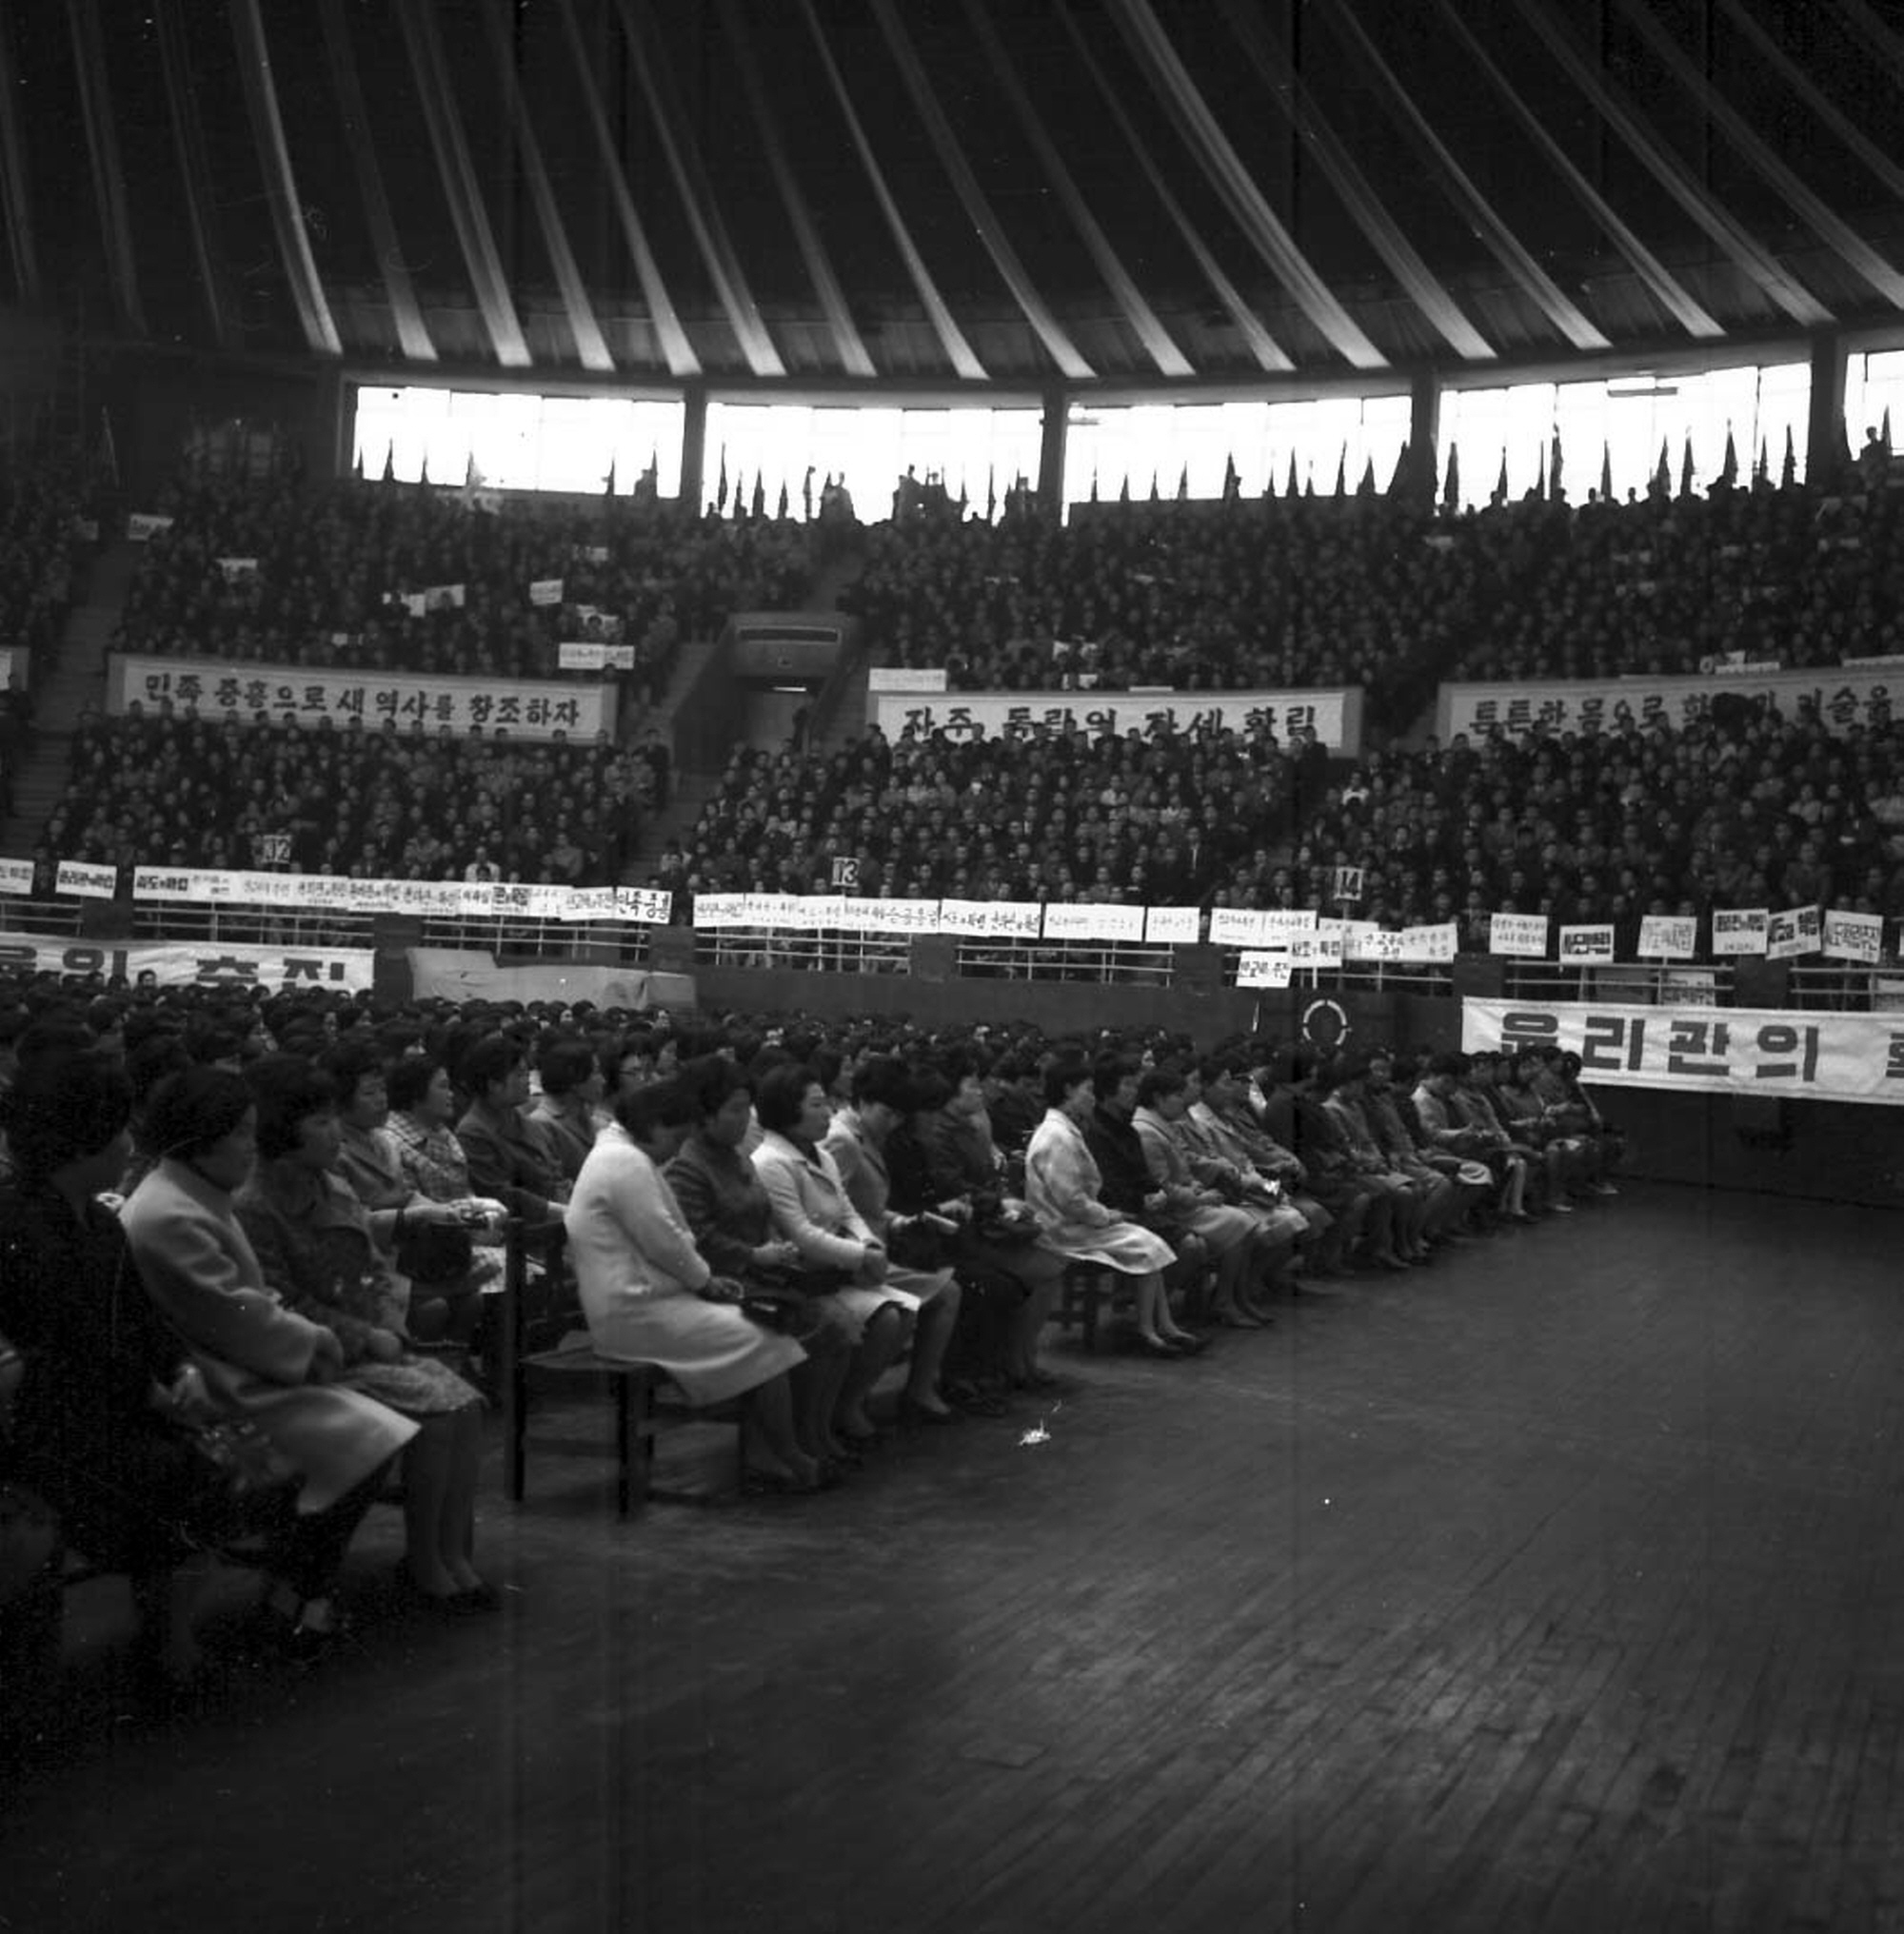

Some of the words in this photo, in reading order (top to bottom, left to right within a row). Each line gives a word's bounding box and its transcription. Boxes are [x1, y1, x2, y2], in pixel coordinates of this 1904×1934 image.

[146, 673, 203, 706] 민족
[215, 678, 327, 712] 중흥으로
[336, 687, 366, 716] 새
[376, 689, 455, 721] 역사를
[469, 694, 580, 727] 창조하자
[905, 705, 973, 738] 자주
[1469, 699, 1567, 734] 튼튼한
[269, 839, 290, 860] 12
[837, 859, 859, 884] 13
[1340, 870, 1360, 897] 14
